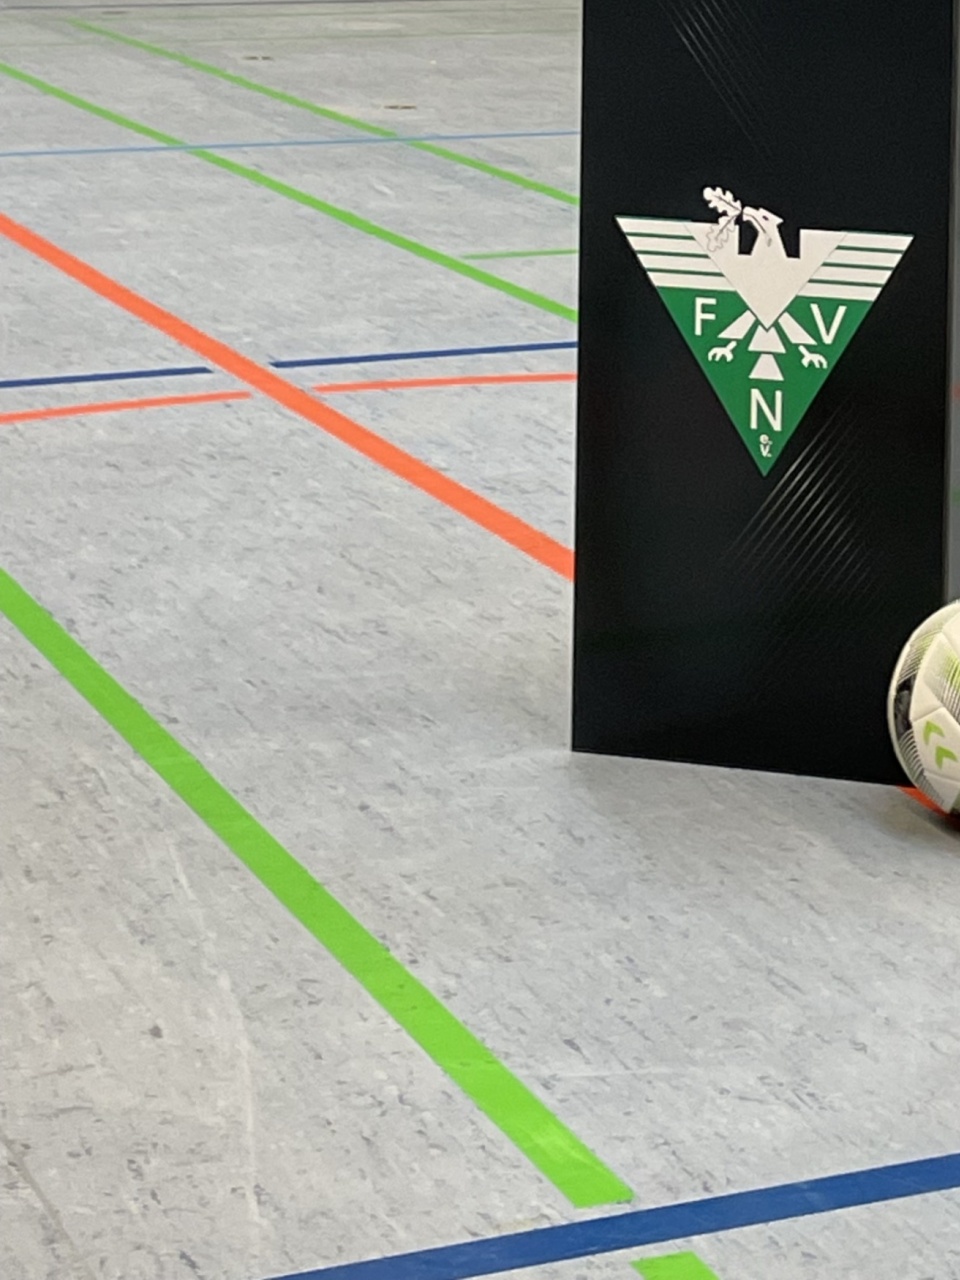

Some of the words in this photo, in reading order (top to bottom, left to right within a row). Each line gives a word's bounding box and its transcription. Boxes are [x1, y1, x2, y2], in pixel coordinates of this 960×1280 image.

[694, 297, 717, 336] F
[809, 303, 847, 345] V
[750, 388, 783, 432] N
